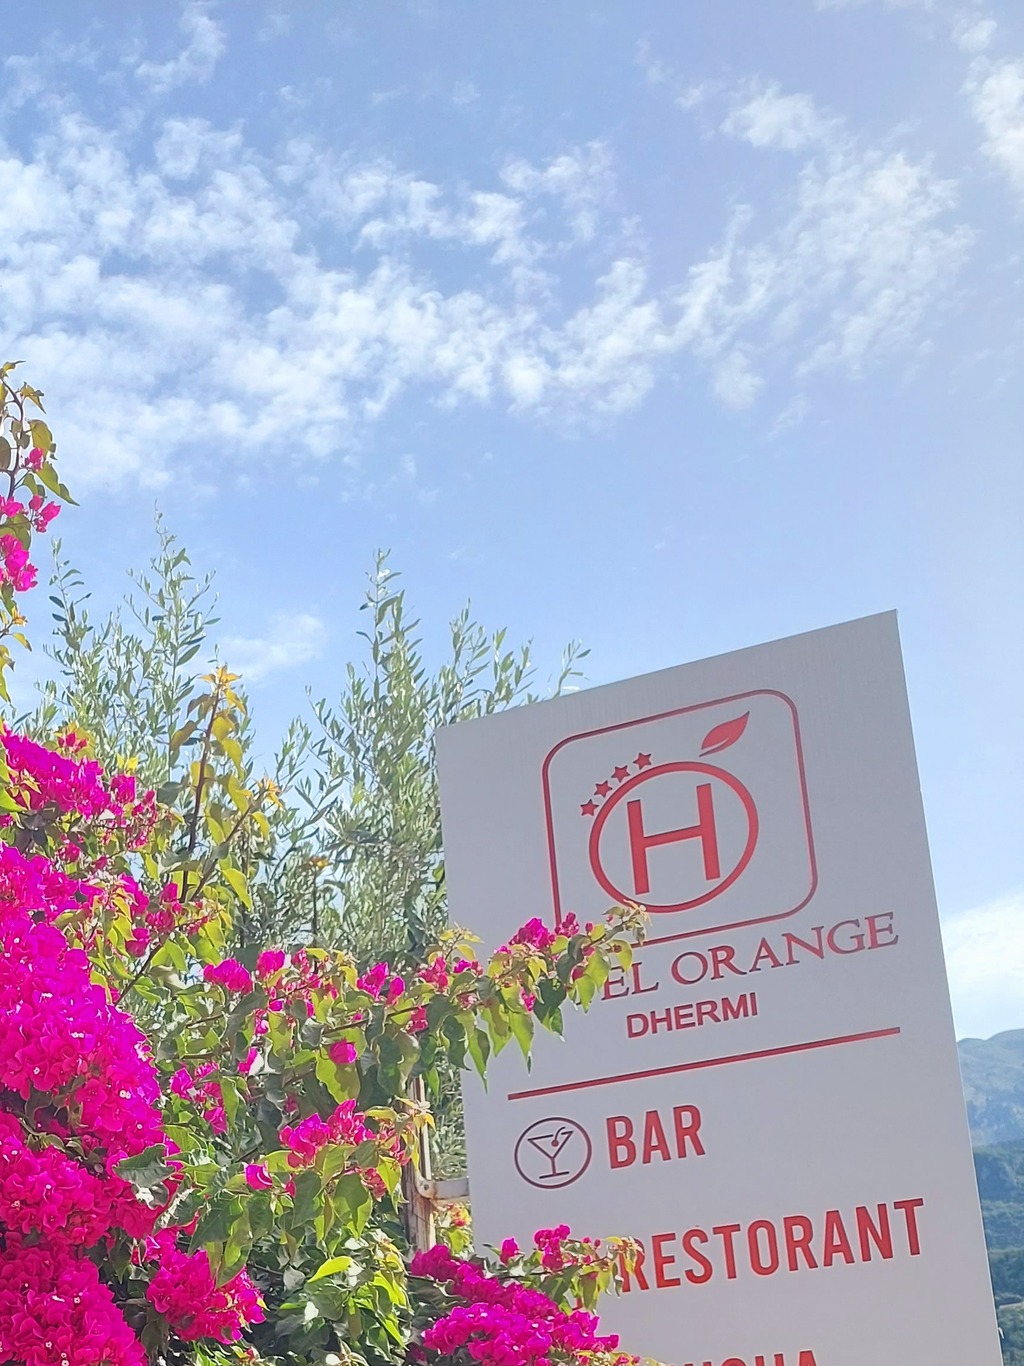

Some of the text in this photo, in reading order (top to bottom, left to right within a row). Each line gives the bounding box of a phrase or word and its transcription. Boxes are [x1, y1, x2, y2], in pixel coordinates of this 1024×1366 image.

[626, 783, 721, 896] H
[576, 912, 900, 1006] EL ORANGE
[626, 992, 759, 1039] DHERMI
[606, 1104, 706, 1169] BAR
[618, 1198, 925, 1293] RESTORANT
